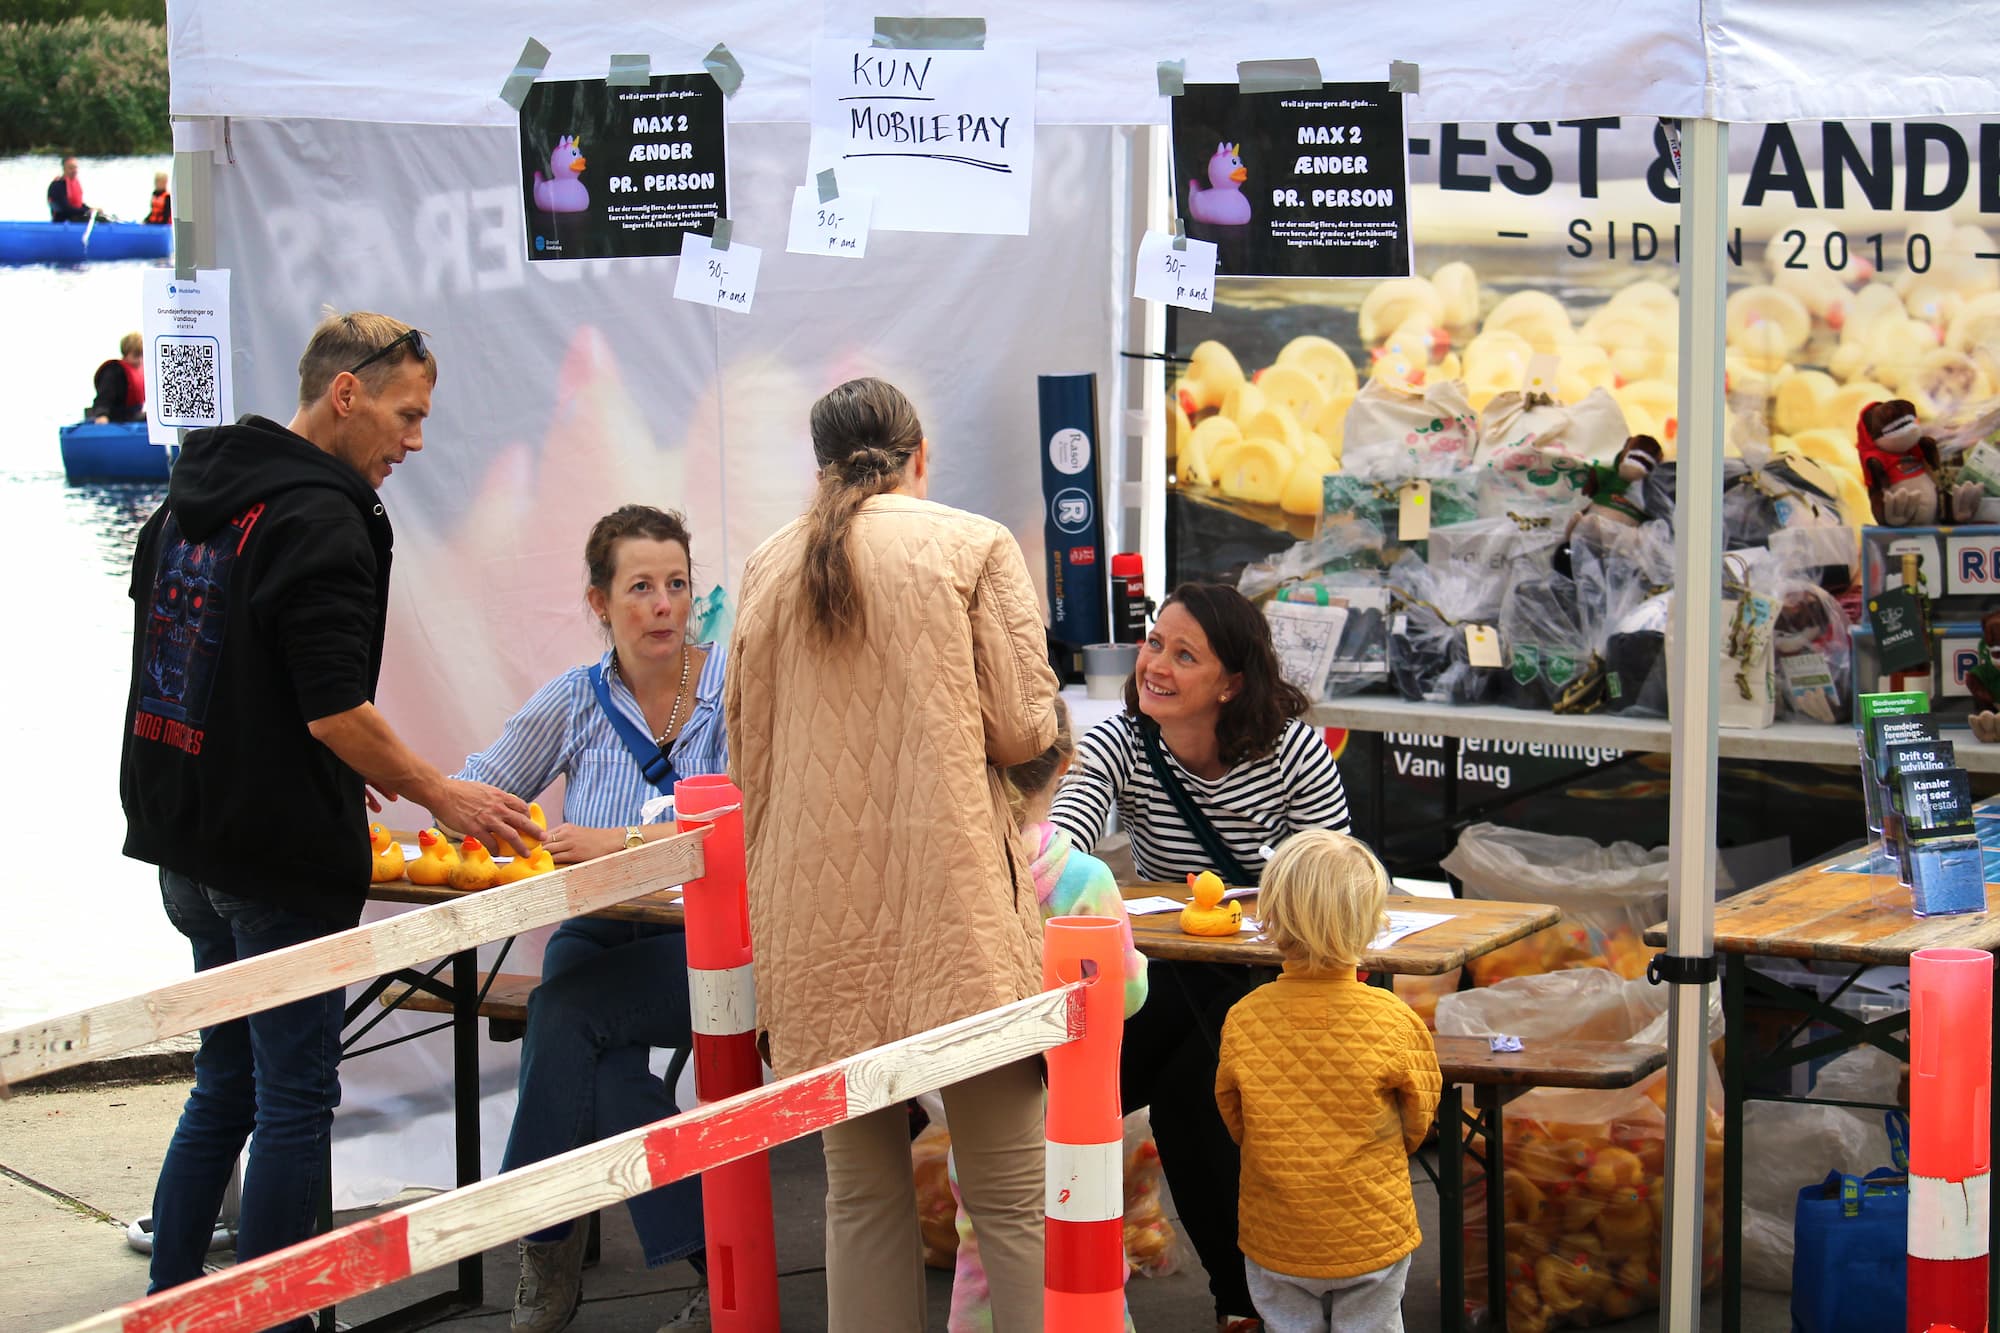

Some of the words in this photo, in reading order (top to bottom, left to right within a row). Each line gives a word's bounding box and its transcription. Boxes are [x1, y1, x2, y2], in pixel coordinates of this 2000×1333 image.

[854, 53, 932, 91] KUN
[633, 115, 673, 134] MAX
[677, 115, 688, 132] 2
[1297, 126, 1345, 145] MAX
[1349, 126, 1362, 144] 2
[629, 143, 693, 162] ÆNDER
[1294, 156, 1368, 174] ÆNDER
[609, 176, 638, 193] PR.
[644, 172, 715, 192] PERSON
[1273, 189, 1305, 207] PR.
[1312, 189, 1393, 207] PERSON
[817, 209, 845, 229] 30,-
[841, 238, 856, 249] and
[1567, 219, 1742, 266] SIDN
[1783, 230, 1931, 274] 2010
[708, 260, 729, 286] 30,-
[1166, 255, 1187, 282] 30,-
[729, 292, 746, 303] and
[1190, 288, 1208, 301] and
[157, 308, 206, 316] Grundejerforeninger
[1884, 722, 1924, 732] Grundejer-
[1885, 730, 1924, 740] forenings-
[1899, 751, 1921, 761] Drift
[1922, 752, 1935, 761] og
[1913, 779, 1950, 791] Kanaler
[1915, 793, 1928, 803] og
[1929, 791, 1951, 800] søer
